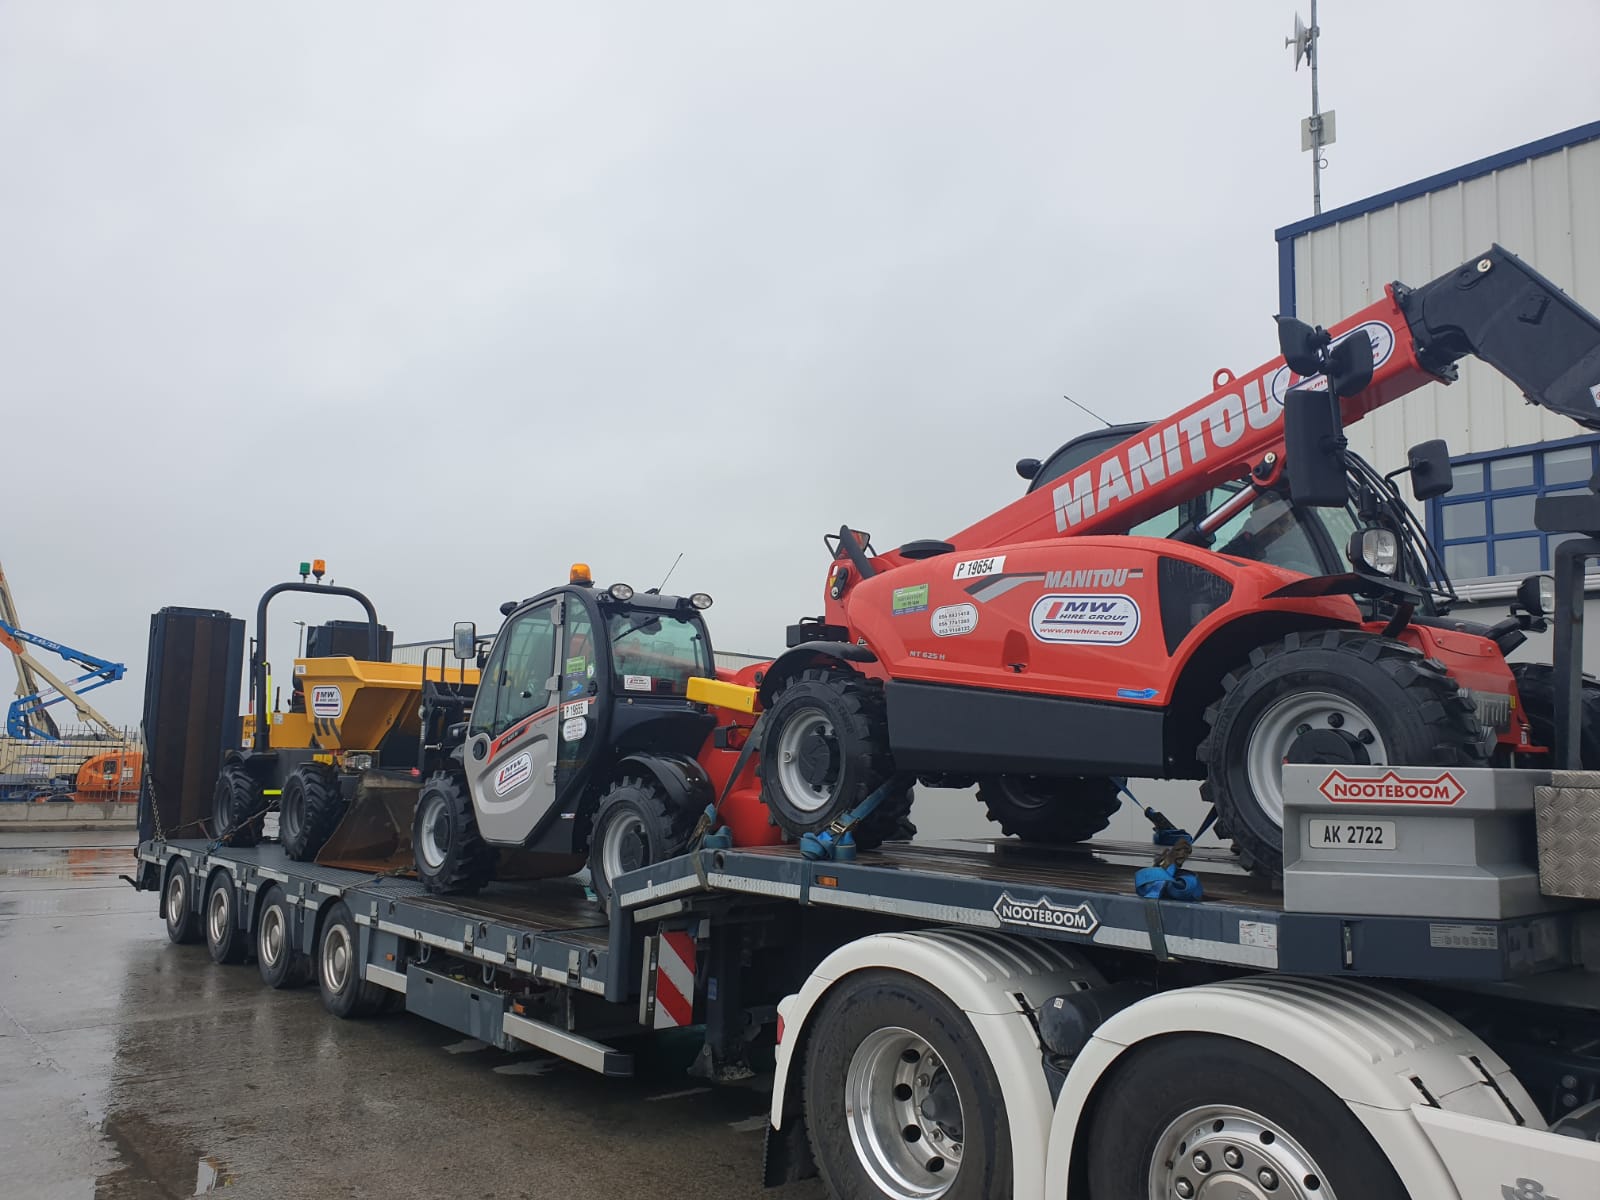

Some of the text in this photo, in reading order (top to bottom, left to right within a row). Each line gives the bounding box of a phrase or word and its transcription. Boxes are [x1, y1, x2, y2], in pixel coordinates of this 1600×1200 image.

[1052, 371, 1286, 533] MANITOU
[957, 559, 995, 577] P 19654
[1044, 569, 1128, 588] MANITOU
[1064, 602, 1117, 612] MW
[1040, 627, 1123, 637] www.mwhire.com
[1334, 783, 1450, 799] NOOTEBOOM
[1323, 825, 1383, 844] AK 2722
[1002, 904, 1087, 928] NOOTEBOOM
